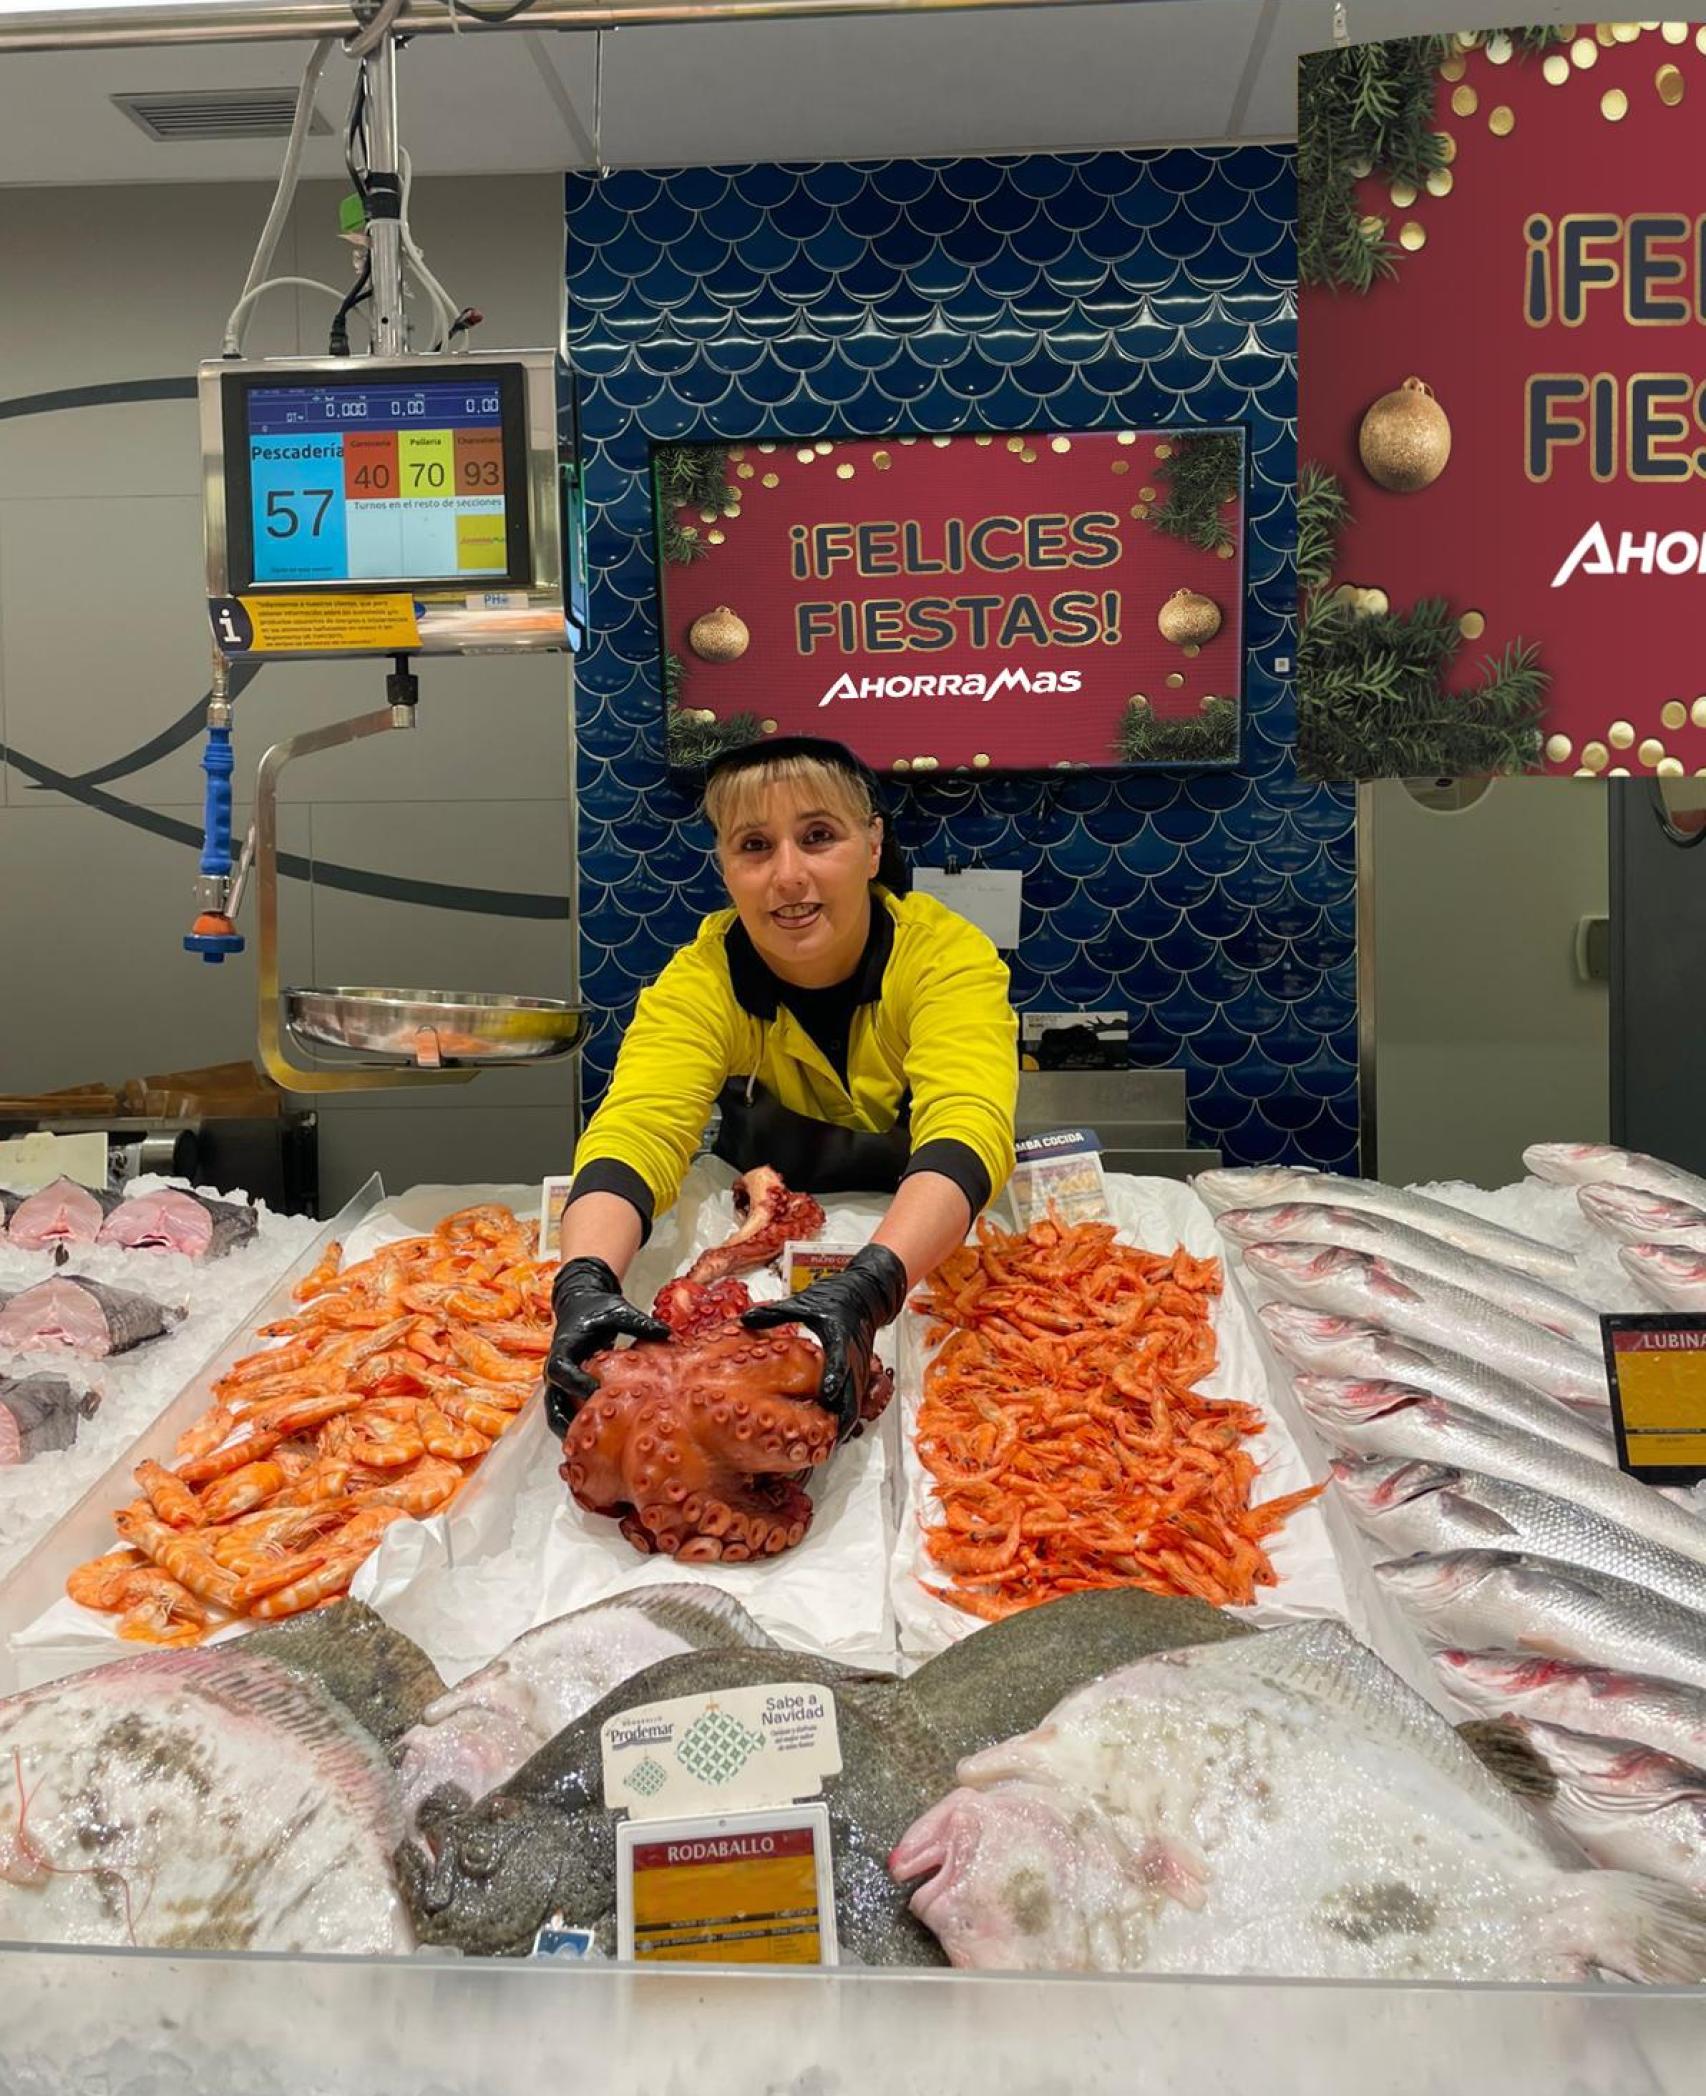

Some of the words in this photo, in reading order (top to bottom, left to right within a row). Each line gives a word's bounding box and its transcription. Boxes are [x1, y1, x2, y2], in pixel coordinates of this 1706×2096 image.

[1523, 212, 1706, 328] ¡FE
[1524, 371, 1706, 483] FIE
[252, 442, 344, 460] Pescadería
[354, 464, 389, 488] 40
[409, 462, 445, 487] 70
[464, 461, 499, 486] 93
[266, 489, 334, 538] 57
[354, 501, 387, 510] Turnos
[403, 500, 412, 508] el
[414, 500, 440, 508] resto
[443, 499, 454, 507] de
[456, 498, 502, 508] secciones
[789, 511, 1123, 580] ¡FELICES
[1550, 520, 1706, 588] AHO
[796, 590, 1122, 655] FIESTAS!
[1042, 1132, 1084, 1147] COCIDA
[762, 1704, 824, 1725] Navidad
[766, 1695, 804, 1711] Sabe
[808, 1694, 817, 1705] a
[610, 1723, 674, 1743] Prodemar
[667, 1836, 775, 1862] RODABALLO
